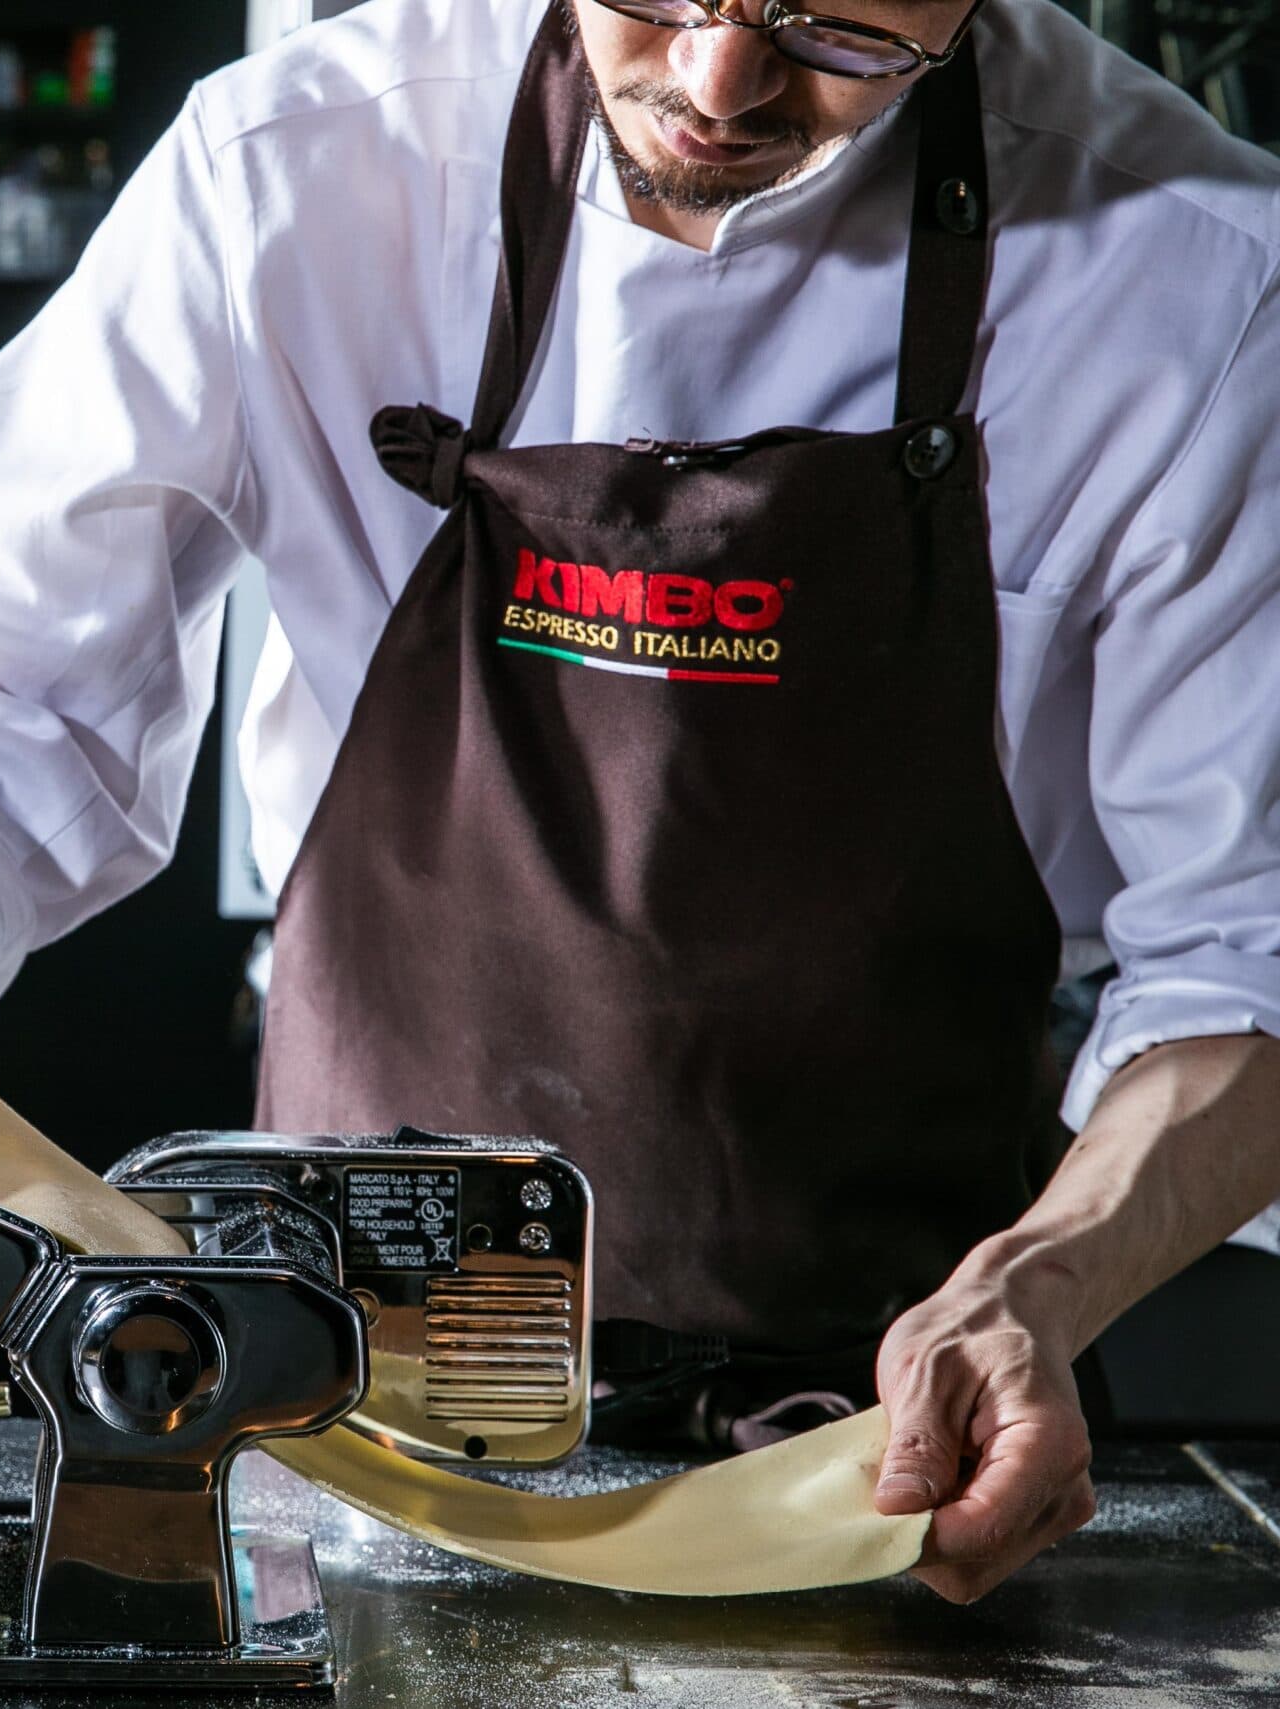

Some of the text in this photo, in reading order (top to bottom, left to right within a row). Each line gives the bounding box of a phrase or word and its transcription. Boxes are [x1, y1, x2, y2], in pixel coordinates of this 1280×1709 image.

[514, 547, 784, 631] KIMBO
[504, 605, 780, 662] ESPRESSO ITALIANO
[349, 1174, 389, 1184] MARCATO
[418, 1174, 440, 1185] ITALY
[349, 1185, 391, 1196] PASTADRIVE
[349, 1198, 413, 1208] FOOD PREPARING
[349, 1208, 382, 1218] MACHINE
[349, 1220, 416, 1230] FOR HOUSEHOLD
[366, 1231, 388, 1241] ONLY
[401, 1244, 424, 1255] POUR
